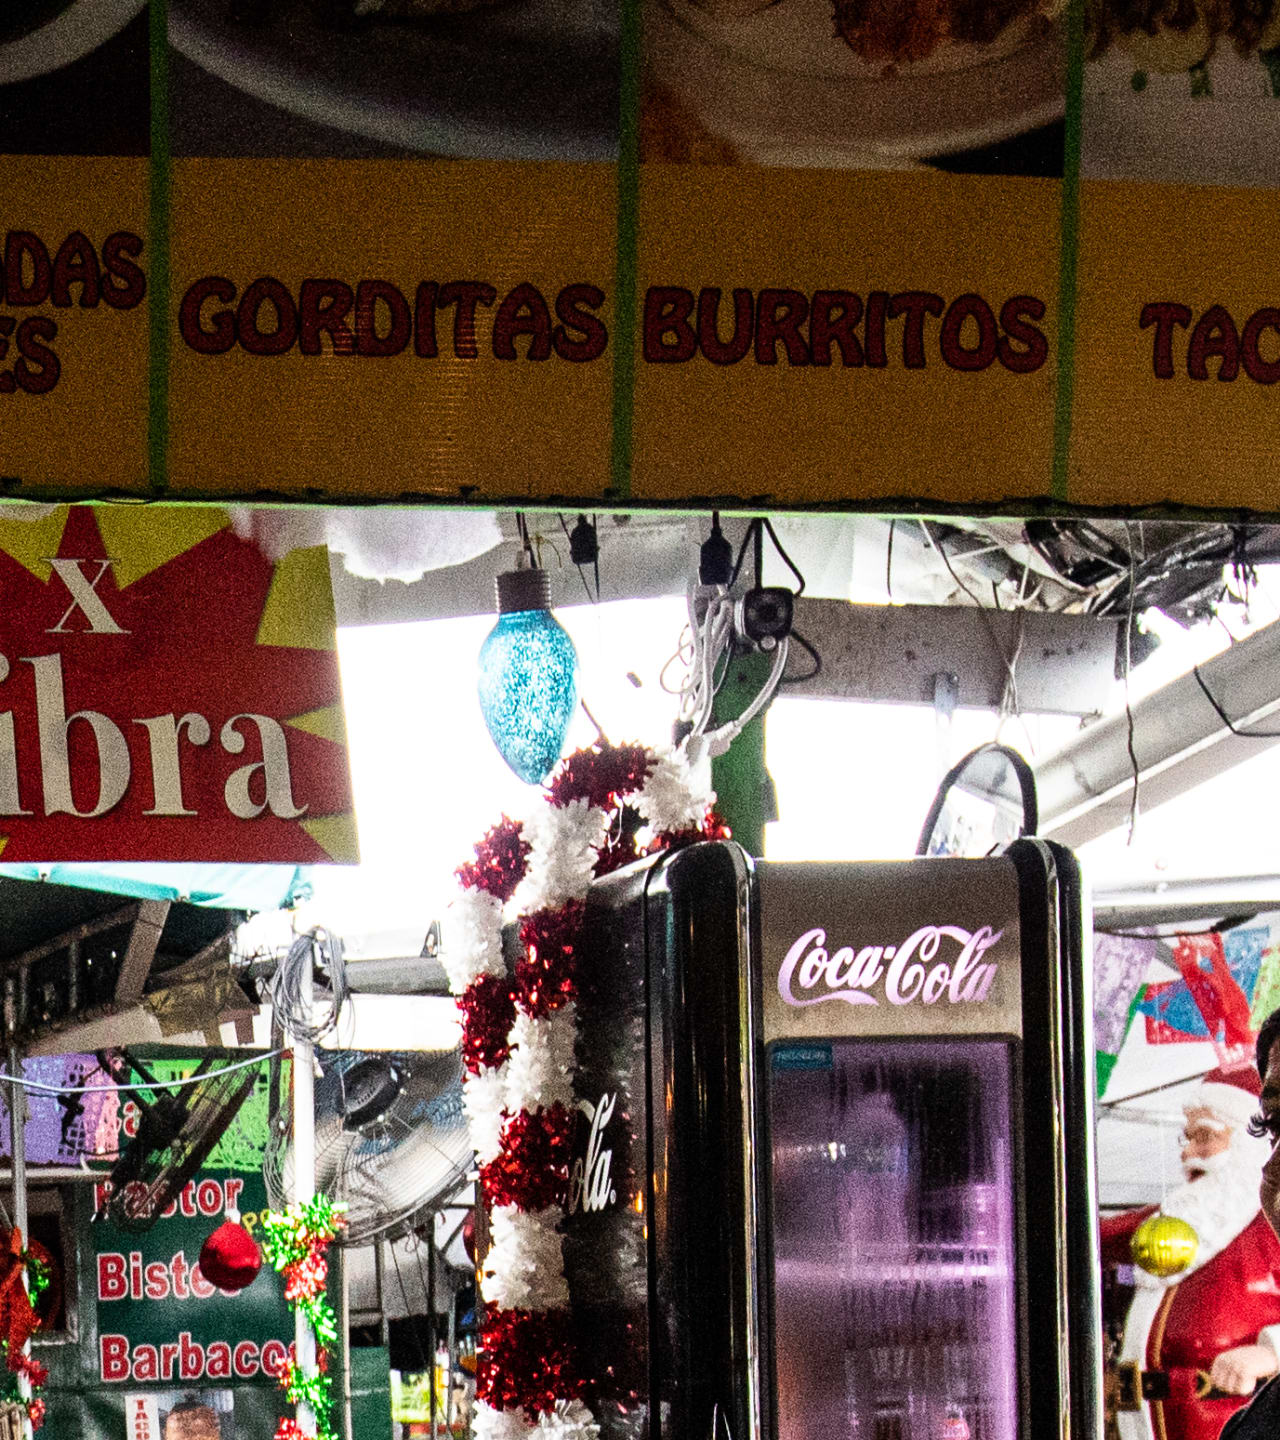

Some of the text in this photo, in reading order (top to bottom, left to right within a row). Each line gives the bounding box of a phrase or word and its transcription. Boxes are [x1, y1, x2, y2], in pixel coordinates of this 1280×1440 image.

[178, 276, 610, 362] GORDITAS
[643, 286, 1050, 374] BURRITOS
[778, 925, 1003, 1007] Coca-Cola
